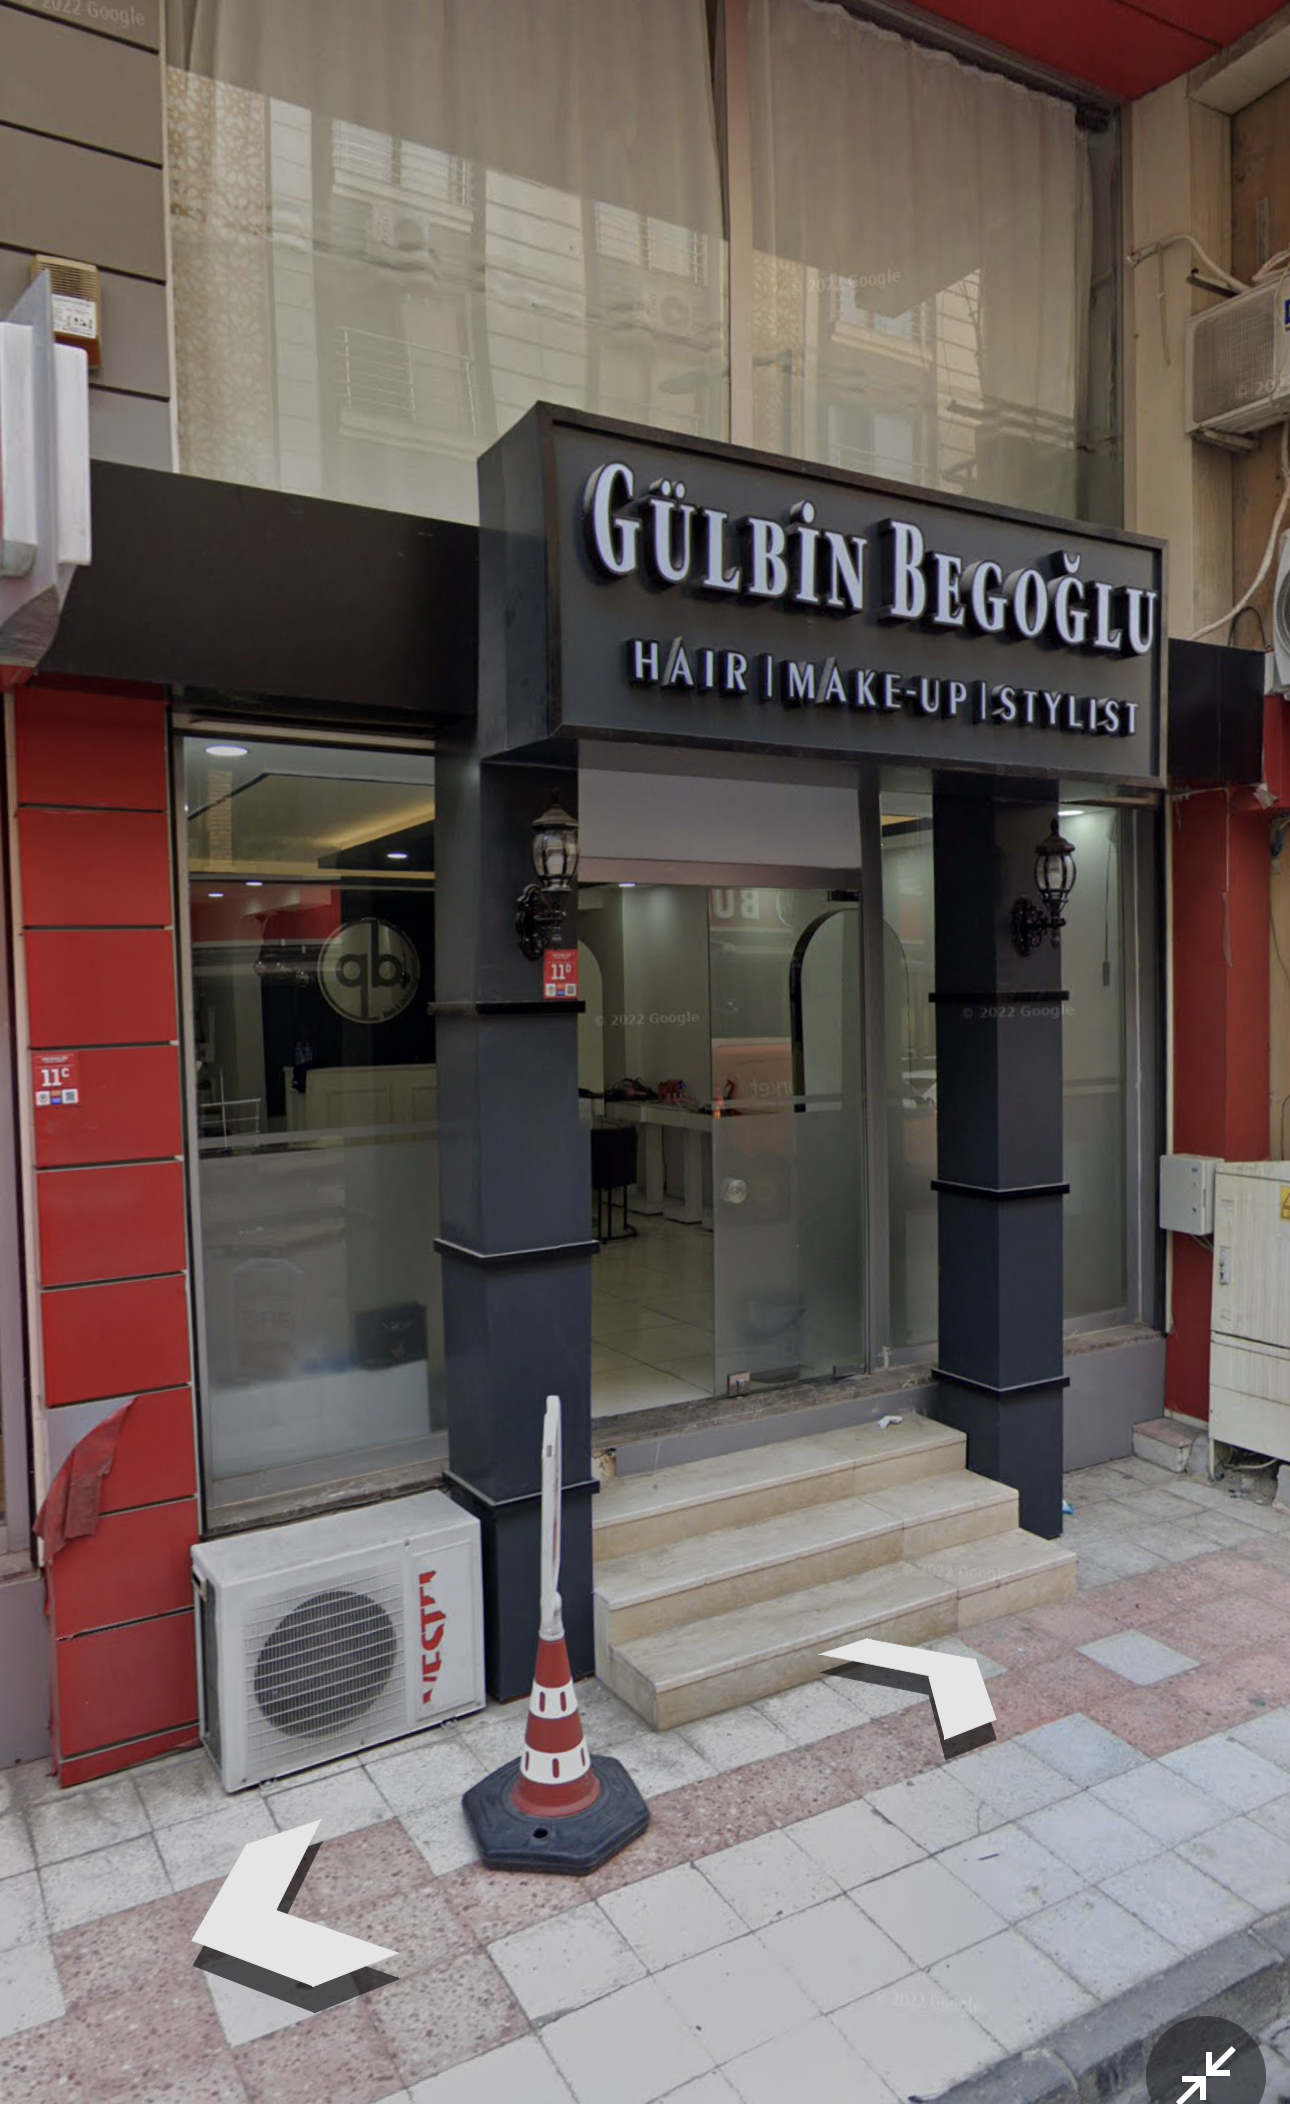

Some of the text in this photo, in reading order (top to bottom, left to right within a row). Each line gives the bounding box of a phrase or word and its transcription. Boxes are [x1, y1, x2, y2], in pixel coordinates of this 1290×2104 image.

[592, 462, 1157, 655] GÜLBİN BEGOĞLU
[633, 640, 748, 692] HAIR
[788, 661, 967, 714] MAKE-UP
[1000, 685, 1139, 734] STYLIST
